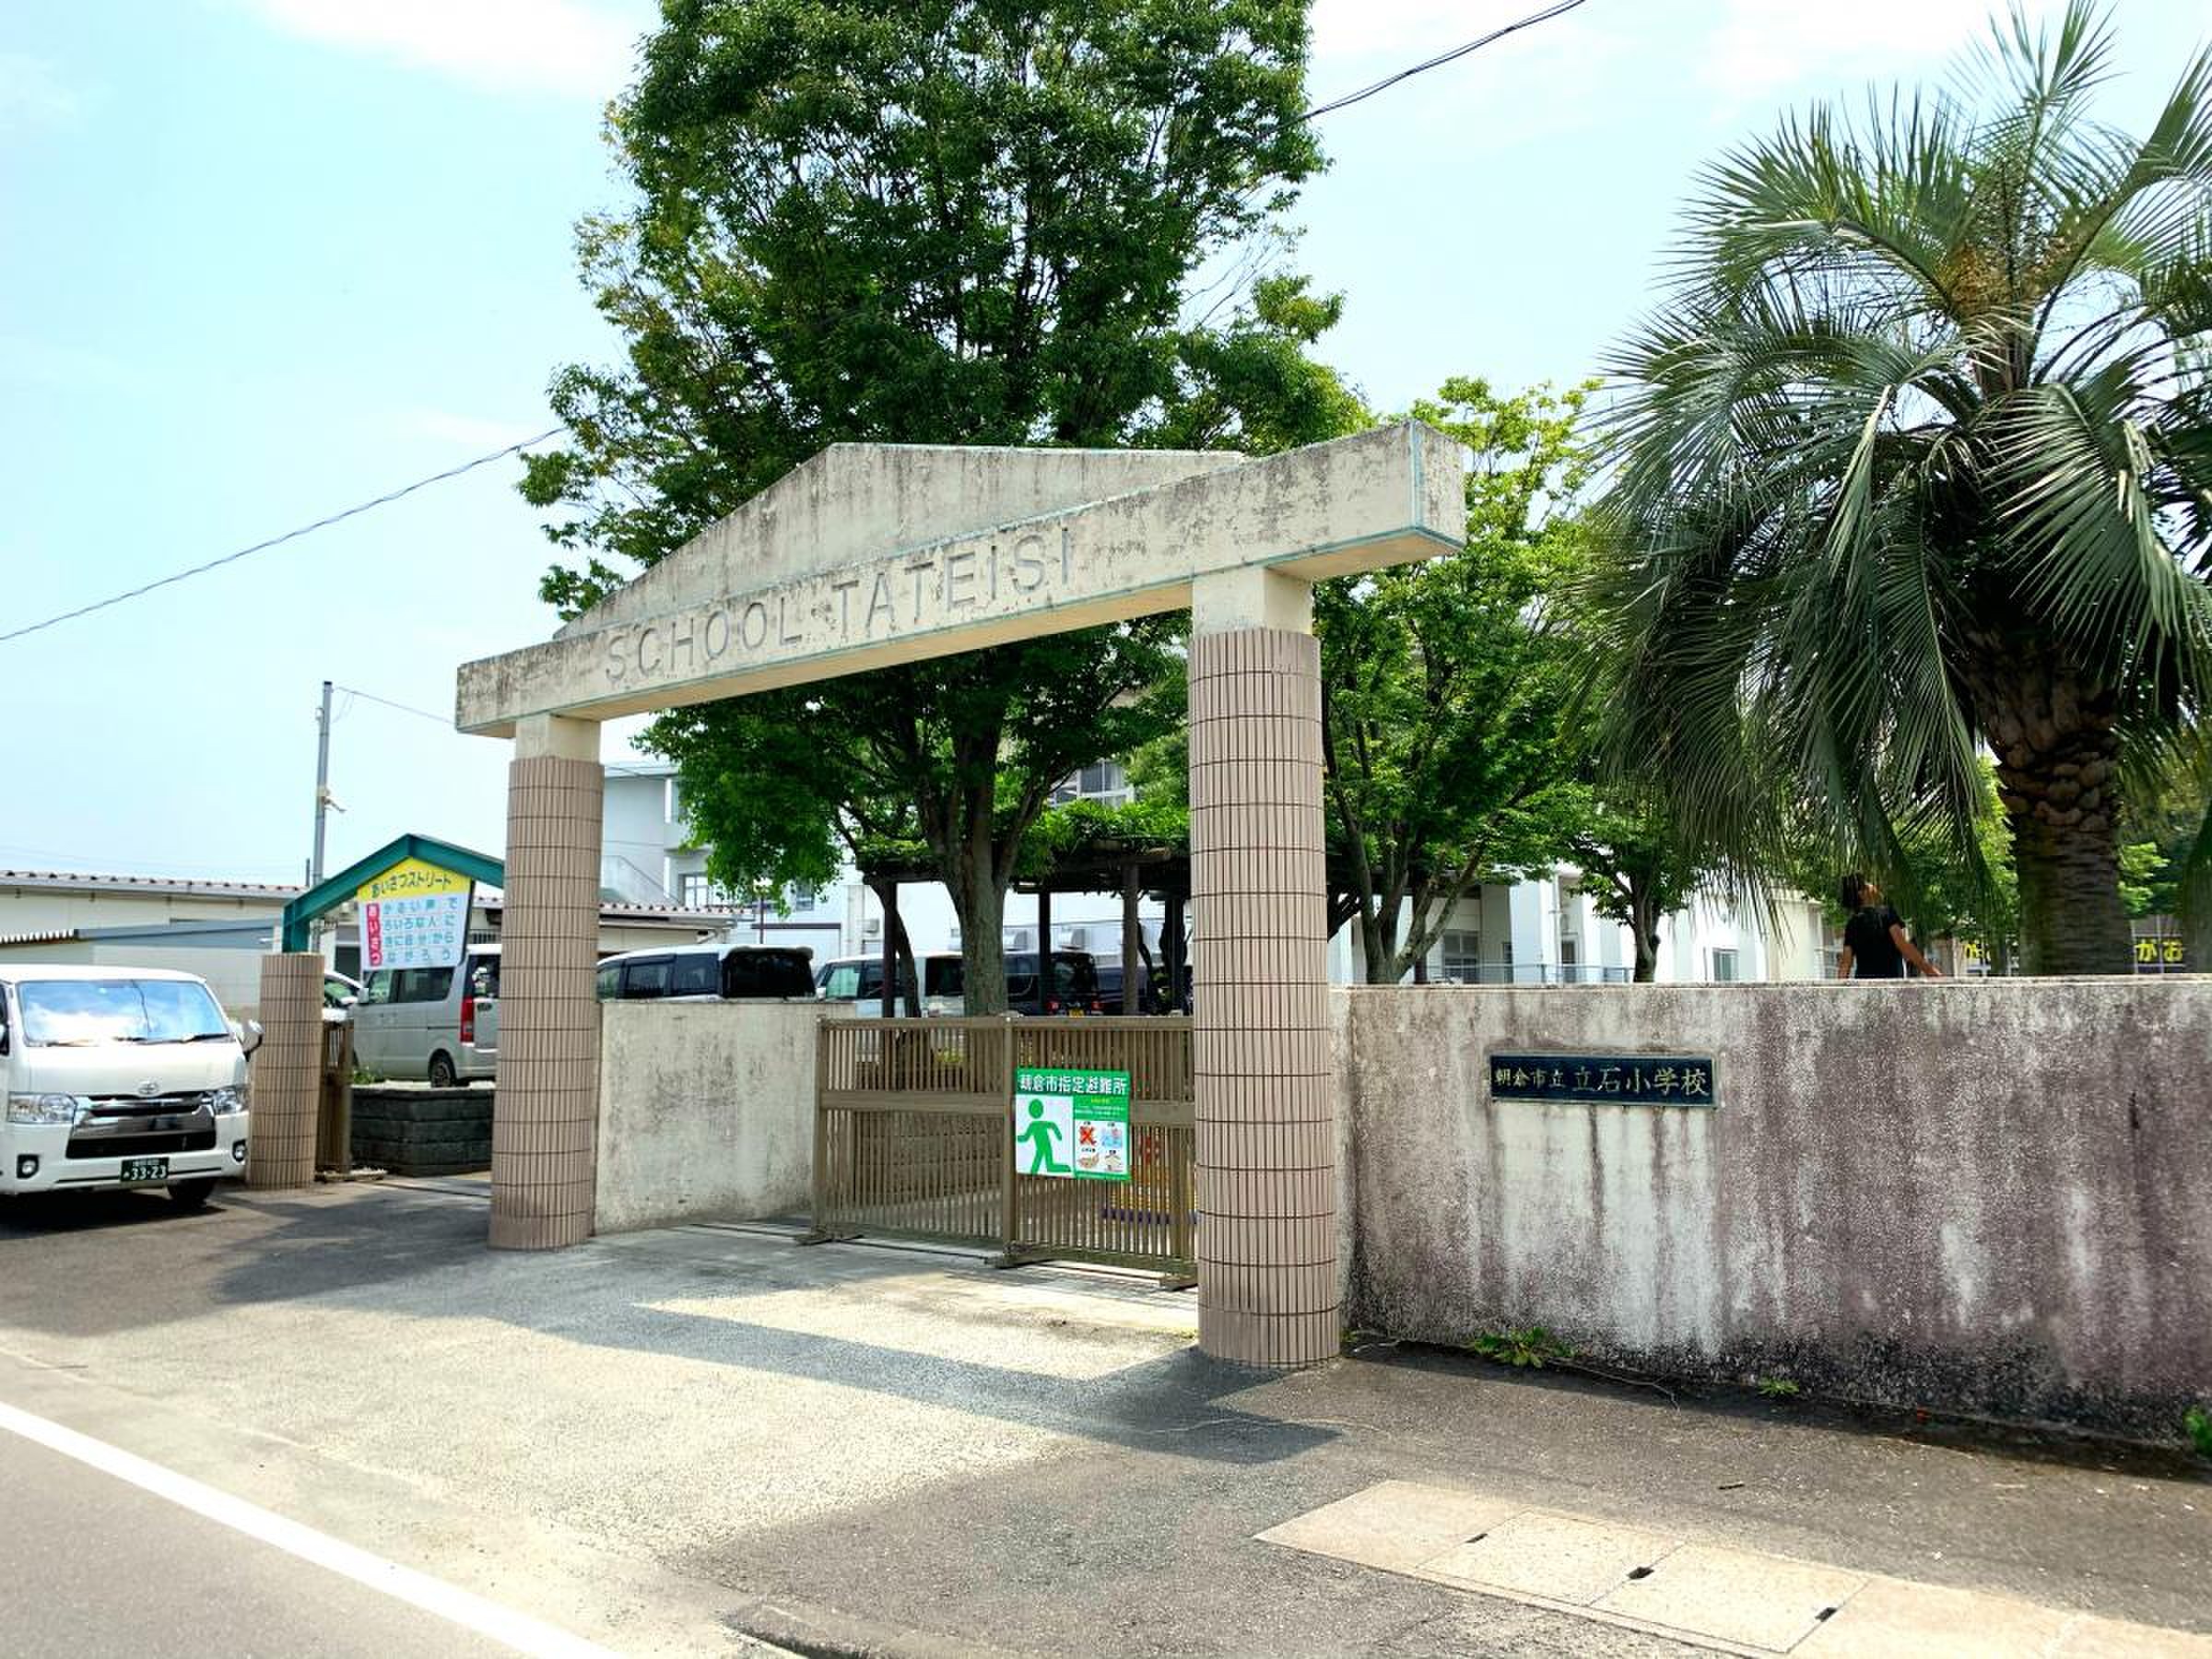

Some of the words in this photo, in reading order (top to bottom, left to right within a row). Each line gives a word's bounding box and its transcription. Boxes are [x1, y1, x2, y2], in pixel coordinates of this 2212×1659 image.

[605, 594, 804, 684] SCHOOL
[831, 526, 1077, 638] TATEISI
[1018, 1074, 1127, 1096] 朝倉市指定避難所
[1493, 1067, 1566, 1089] 朝倉市立
[1571, 1065, 1711, 1096] 立石小学校
